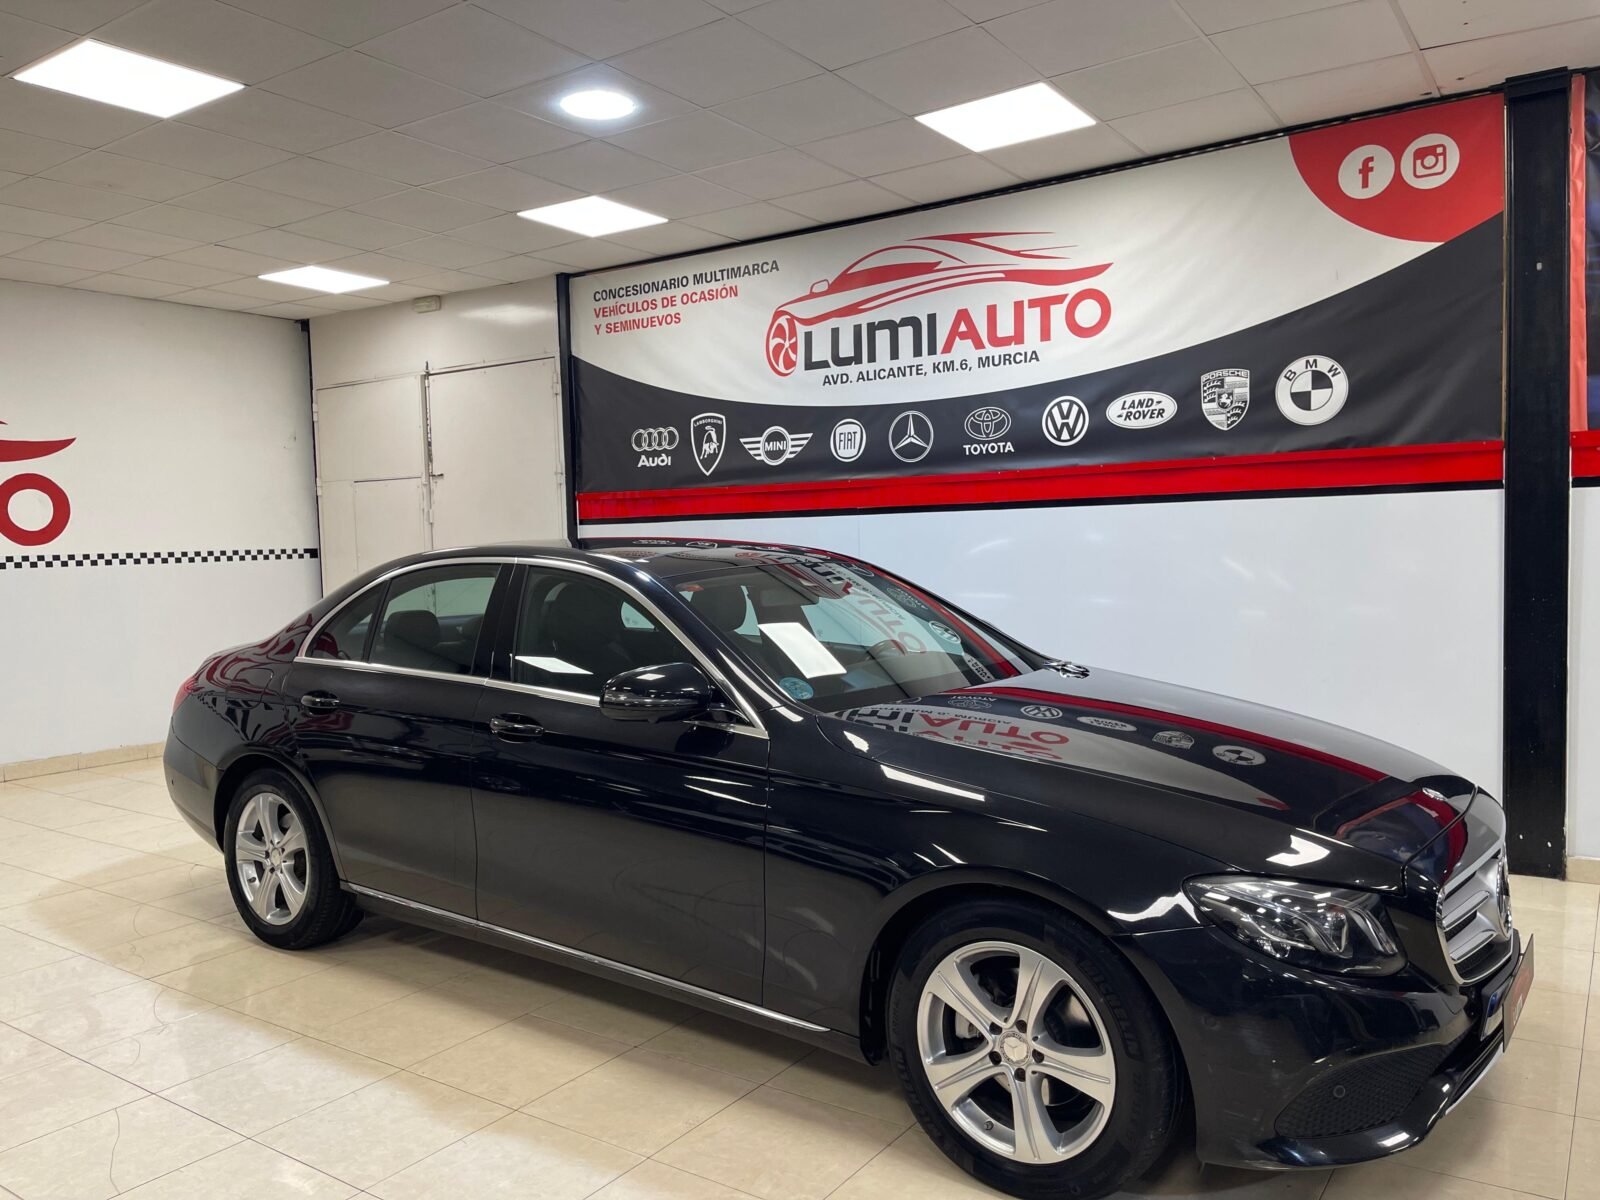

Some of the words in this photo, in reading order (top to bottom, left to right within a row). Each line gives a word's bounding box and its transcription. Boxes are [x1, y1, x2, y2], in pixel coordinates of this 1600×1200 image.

[593, 275, 690, 302] CONCESIONARIO
[693, 259, 780, 286] MULTIMARCA
[594, 298, 658, 319] VEHÍCULOS
[661, 295, 677, 309] DE
[680, 283, 738, 306] OCASIÓN
[594, 323, 602, 336] Y
[605, 312, 681, 335] SEMINUEVOS
[822, 372, 853, 387] AVD.
[856, 363, 928, 383] ALICANTE,
[932, 357, 973, 374] KM.6,
[978, 350, 1040, 369] MURCIA
[1202, 370, 1249, 382] PORSCHE
[1283, 358, 1342, 382] BMW
[1120, 397, 1153, 411] LAND
[1123, 407, 1166, 421] ROVER
[764, 440, 787, 452] MINI
[838, 430, 858, 451] FIAT
[963, 442, 1015, 456] TOYOTA
[637, 453, 672, 468] Audi
